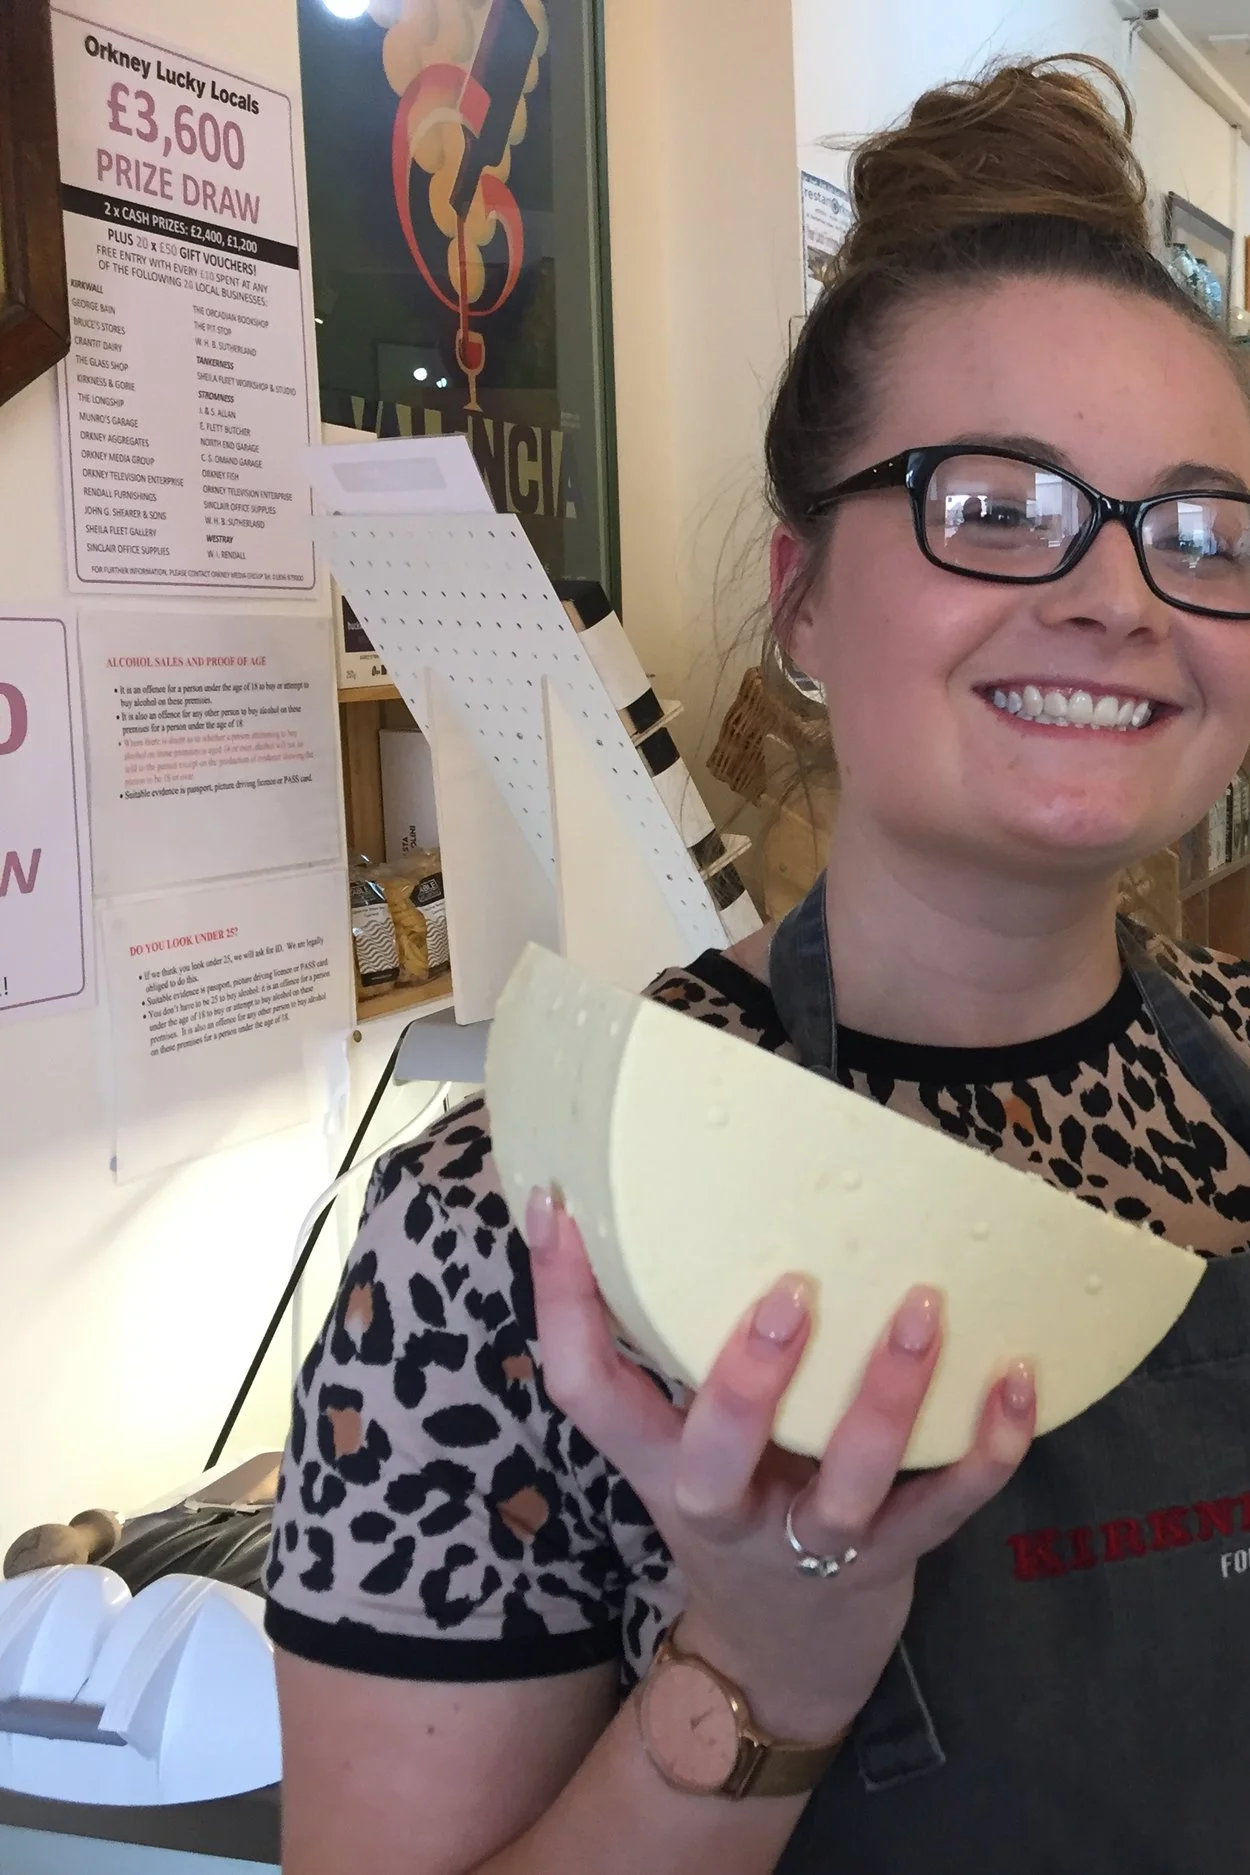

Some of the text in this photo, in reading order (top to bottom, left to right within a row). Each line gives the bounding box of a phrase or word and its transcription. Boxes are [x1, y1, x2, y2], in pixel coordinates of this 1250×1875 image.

[84, 35, 259, 115] Orkney Lucky Locals
[107, 82, 245, 170] £3,600
[97, 149, 260, 224] PRIZE DRAW
[104, 202, 258, 254] 2 x CASH PRIZES: £2,400, £1,200
[108, 228, 257, 276] PLUS 20 x £50 GIFT VOUCHERS!
[96, 244, 117, 259] FREE
[120, 250, 147, 265] ENTRY
[149, 257, 171, 271] WITH
[174, 263, 198, 276] EVERY
[216, 273, 240, 287] SPENT
[242, 279, 251, 290] AT
[253, 283, 268, 294] ANY
[70, 279, 104, 294] KIRKWALL
[98, 259, 110, 271] OF
[112, 262, 129, 276] THE
[132, 267, 182, 287] FOLLOWING
[195, 282, 219, 297] LOCAL
[72, 297, 99, 311] GEORGE
[73, 316, 126, 335] BRUCE'S STORES
[75, 354, 129, 371] THE GLASS SHOP
[196, 355, 234, 370] TANKERNESS
[77, 374, 107, 387] KIRKNESS
[115, 380, 136, 391] GORIE
[78, 392, 124, 407] THE LONGSHIP
[198, 390, 234, 403] STROMNESS
[112, 416, 138, 428] GARAGE
[80, 430, 150, 447] ORKNEY AGGREGATES
[81, 449, 155, 466] ORKNEY MEDIA GROUP
[82, 468, 184, 487] ORKNEY TELEVISION ENTERPRISE
[83, 487, 112, 498] RENDALL
[84, 506, 103, 516] JOHN
[149, 511, 167, 520] SONS
[85, 524, 109, 534] SHEILA
[109, 526, 128, 536] FLEET
[206, 534, 234, 543] WESTRAY
[86, 543, 170, 556] SINCLAIR OFFICE SUPPLIES
[107, 656, 266, 668] ALCOHOL SALES AND PROOF OF AGE
[129, 926, 239, 957] DO YOU LOOK UNDER 25?
